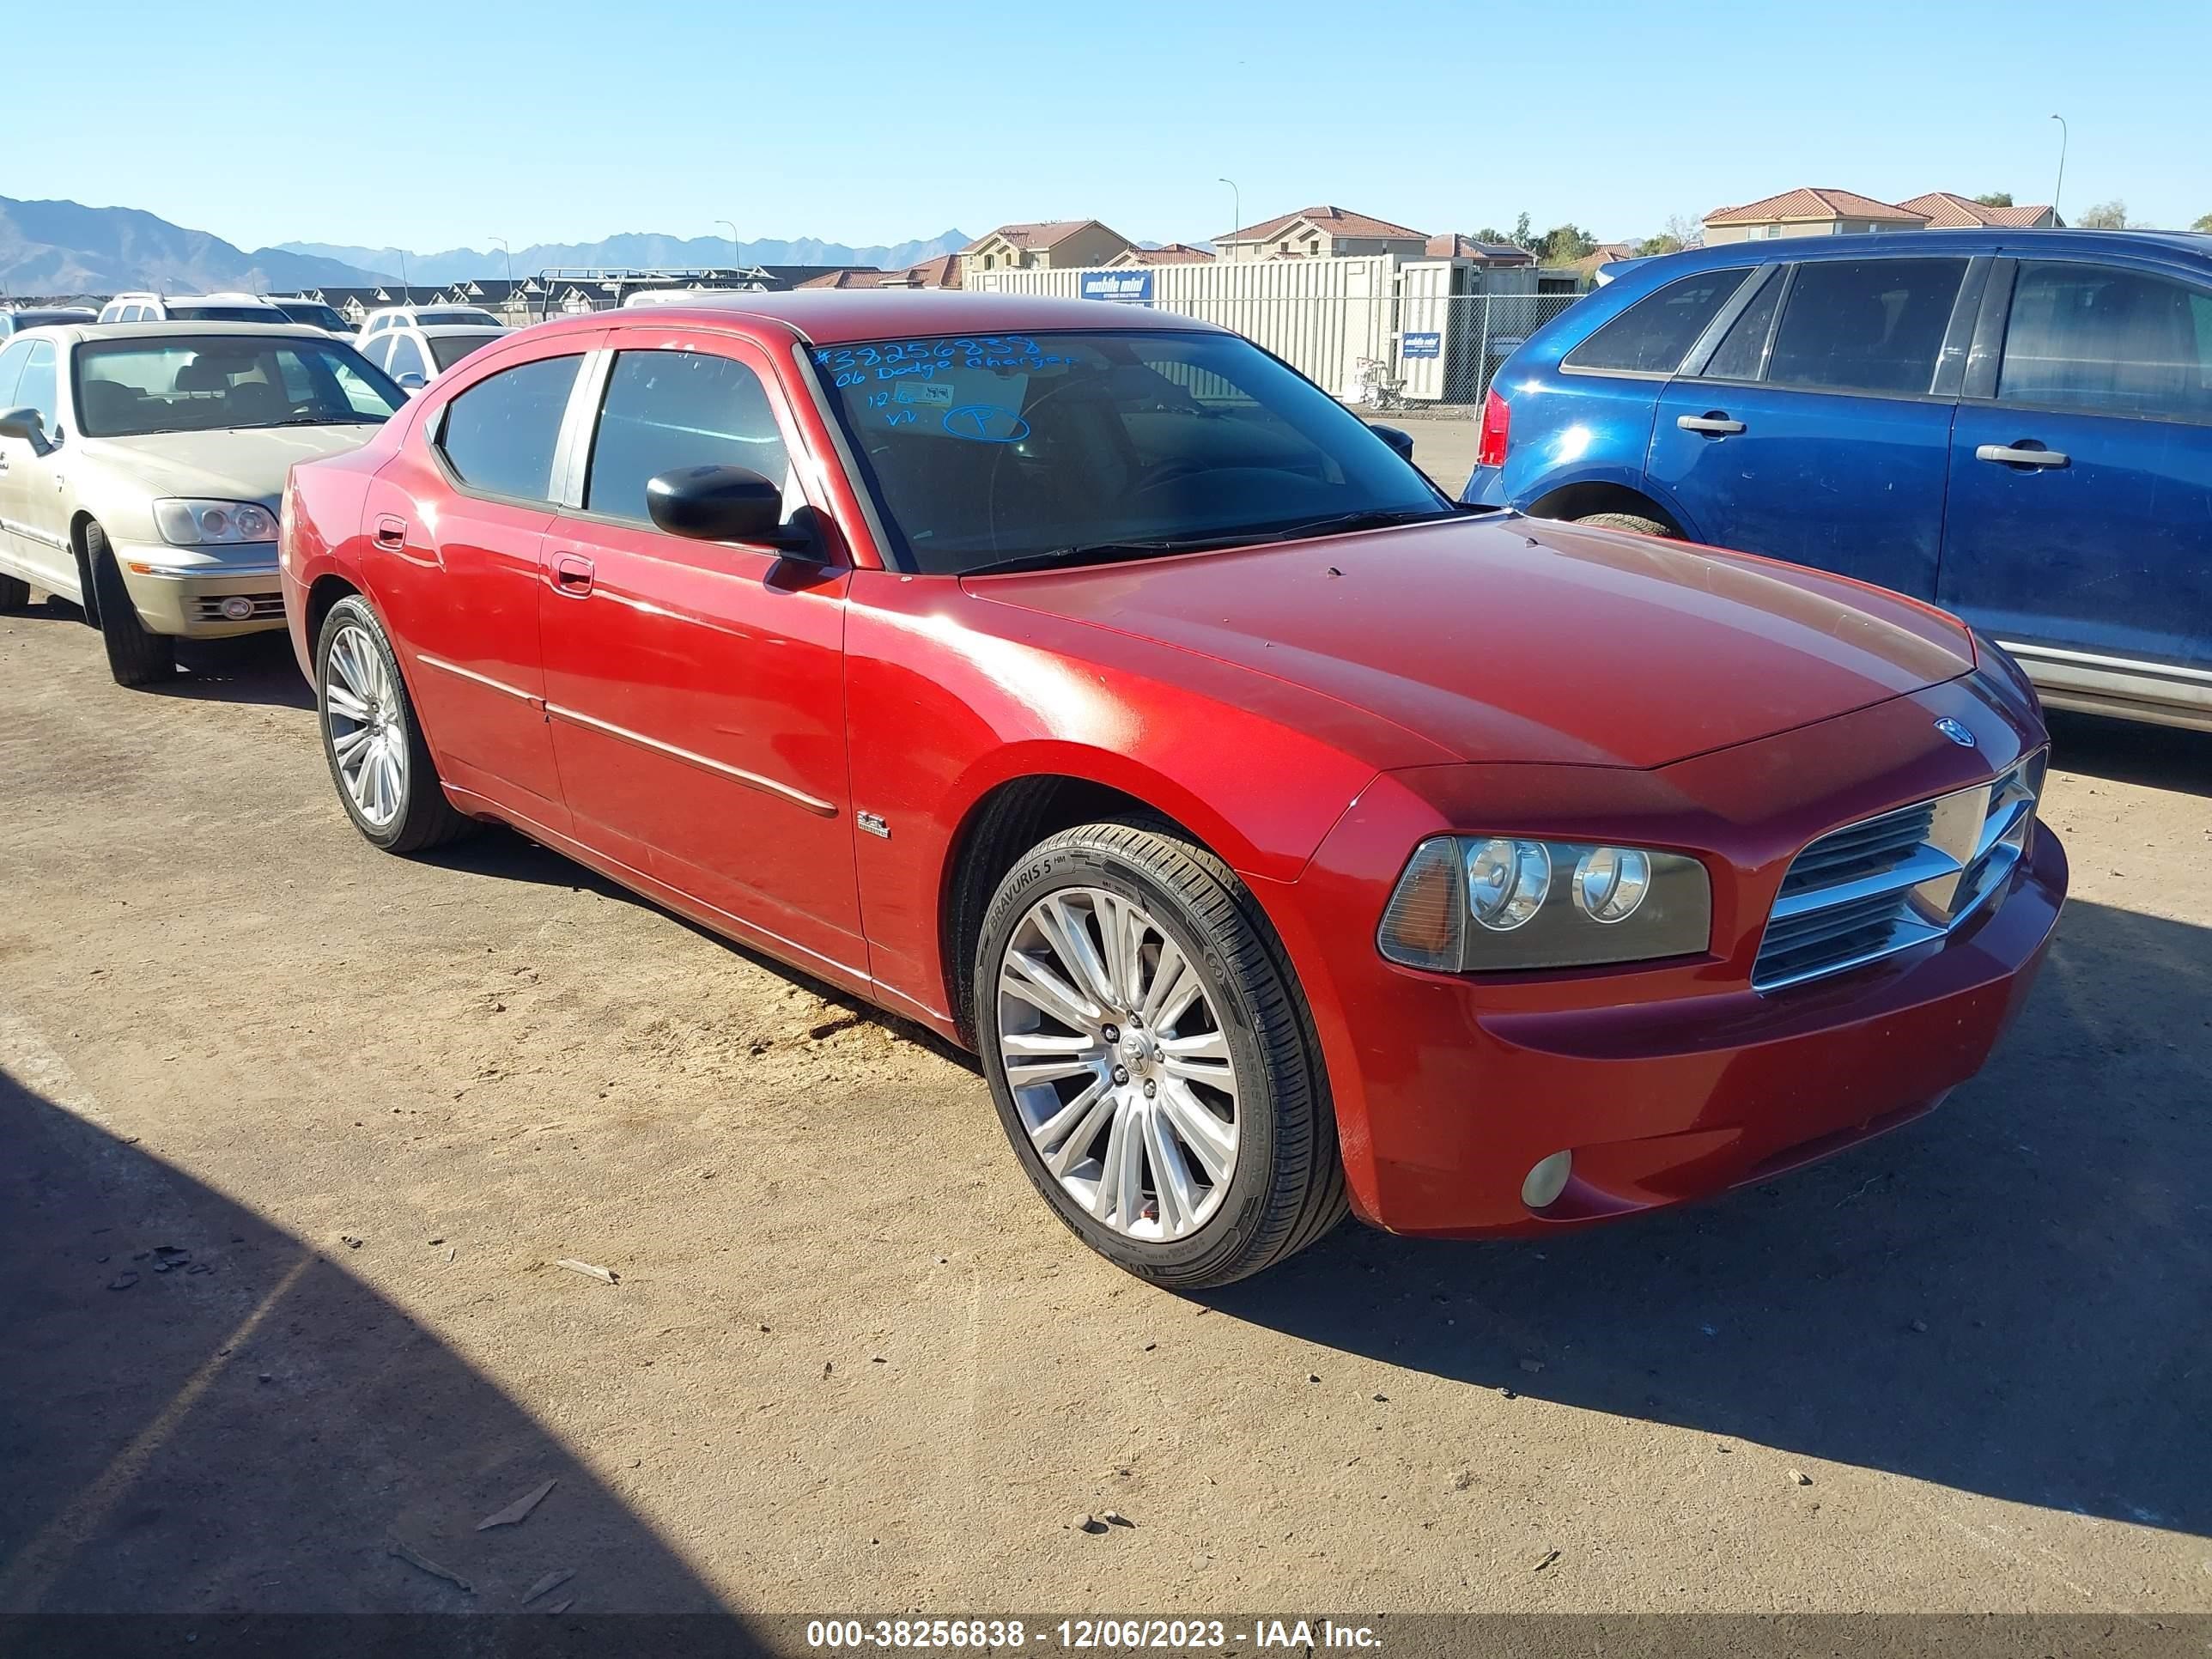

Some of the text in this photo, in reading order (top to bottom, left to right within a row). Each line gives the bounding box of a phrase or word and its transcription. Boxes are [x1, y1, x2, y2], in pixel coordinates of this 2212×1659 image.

[1085, 275, 1146, 294] mobile mini
[836, 356, 1079, 387] 06 Dodge Charger
[989, 864, 1041, 931] BRAVURIS
[1043, 860, 1051, 874] 5
